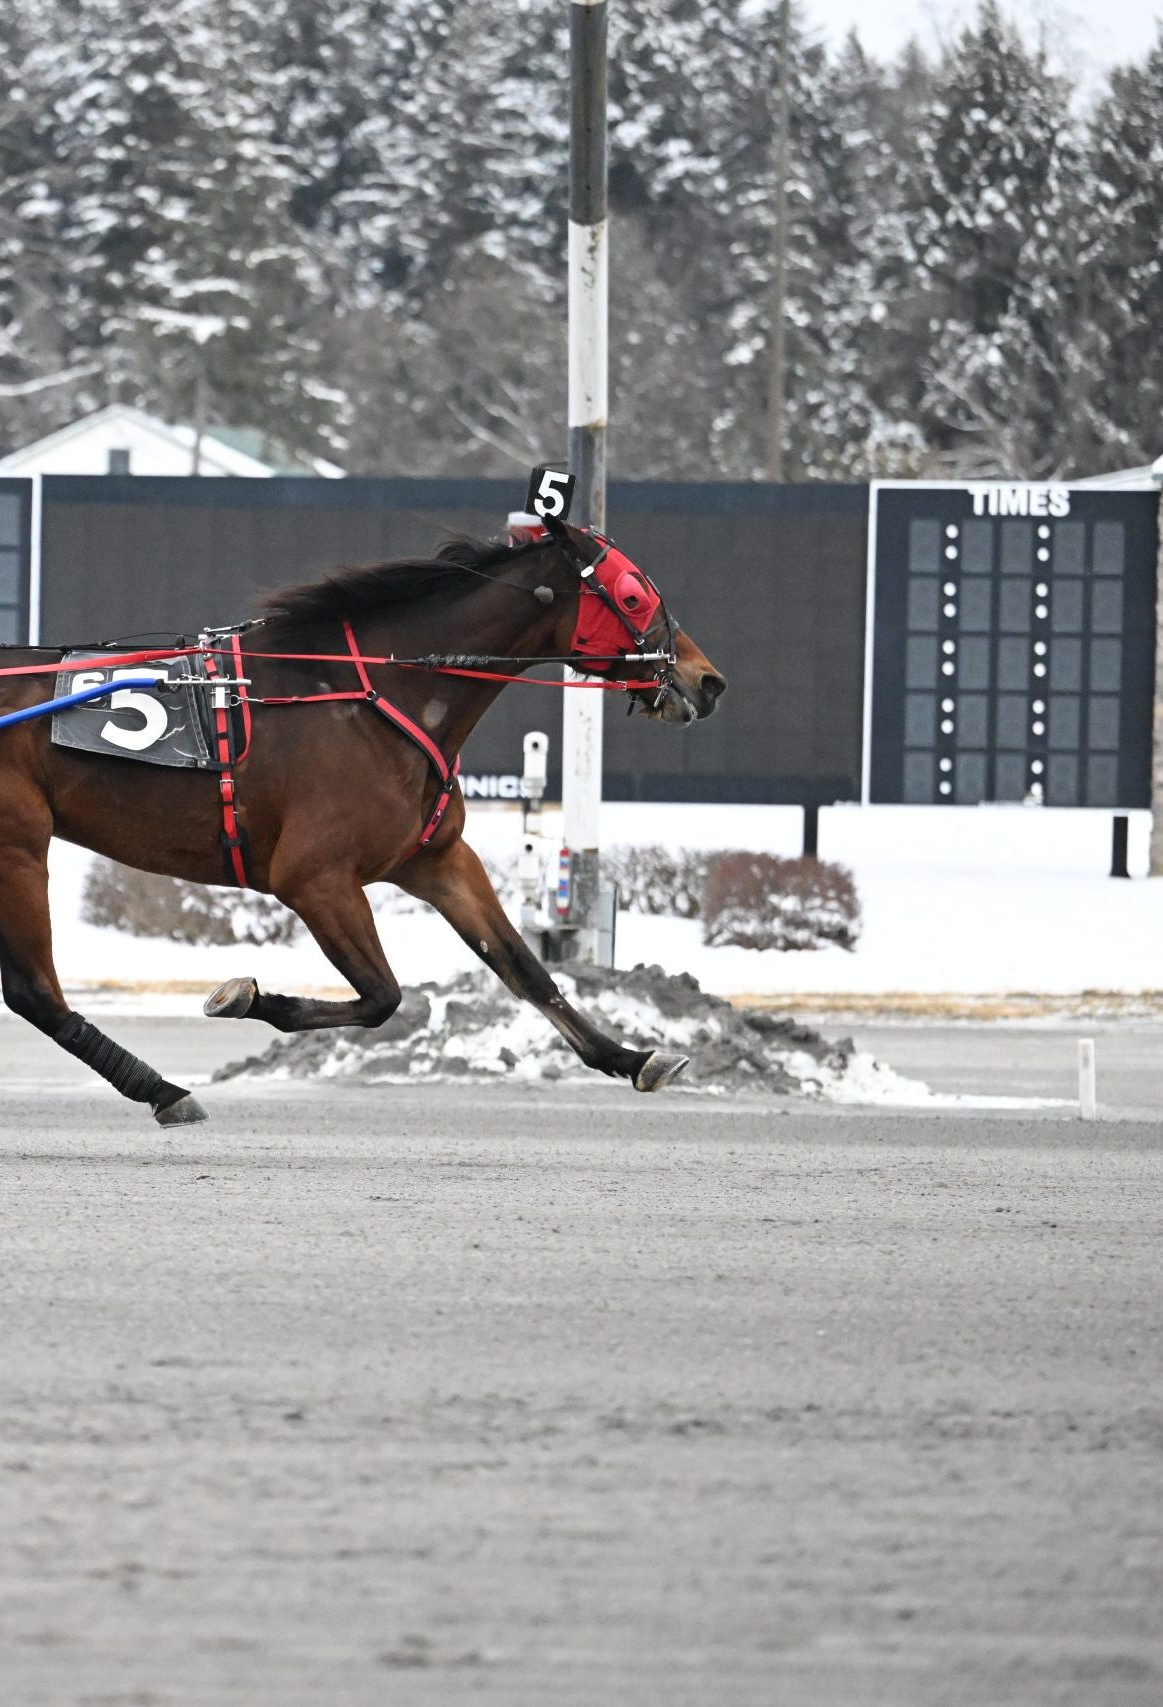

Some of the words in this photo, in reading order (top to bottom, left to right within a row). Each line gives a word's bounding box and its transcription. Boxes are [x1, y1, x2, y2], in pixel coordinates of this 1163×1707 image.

[534, 470, 569, 517] 5
[967, 484, 1071, 517] TIMES
[71, 671, 105, 703] 6
[100, 668, 169, 751] 5
